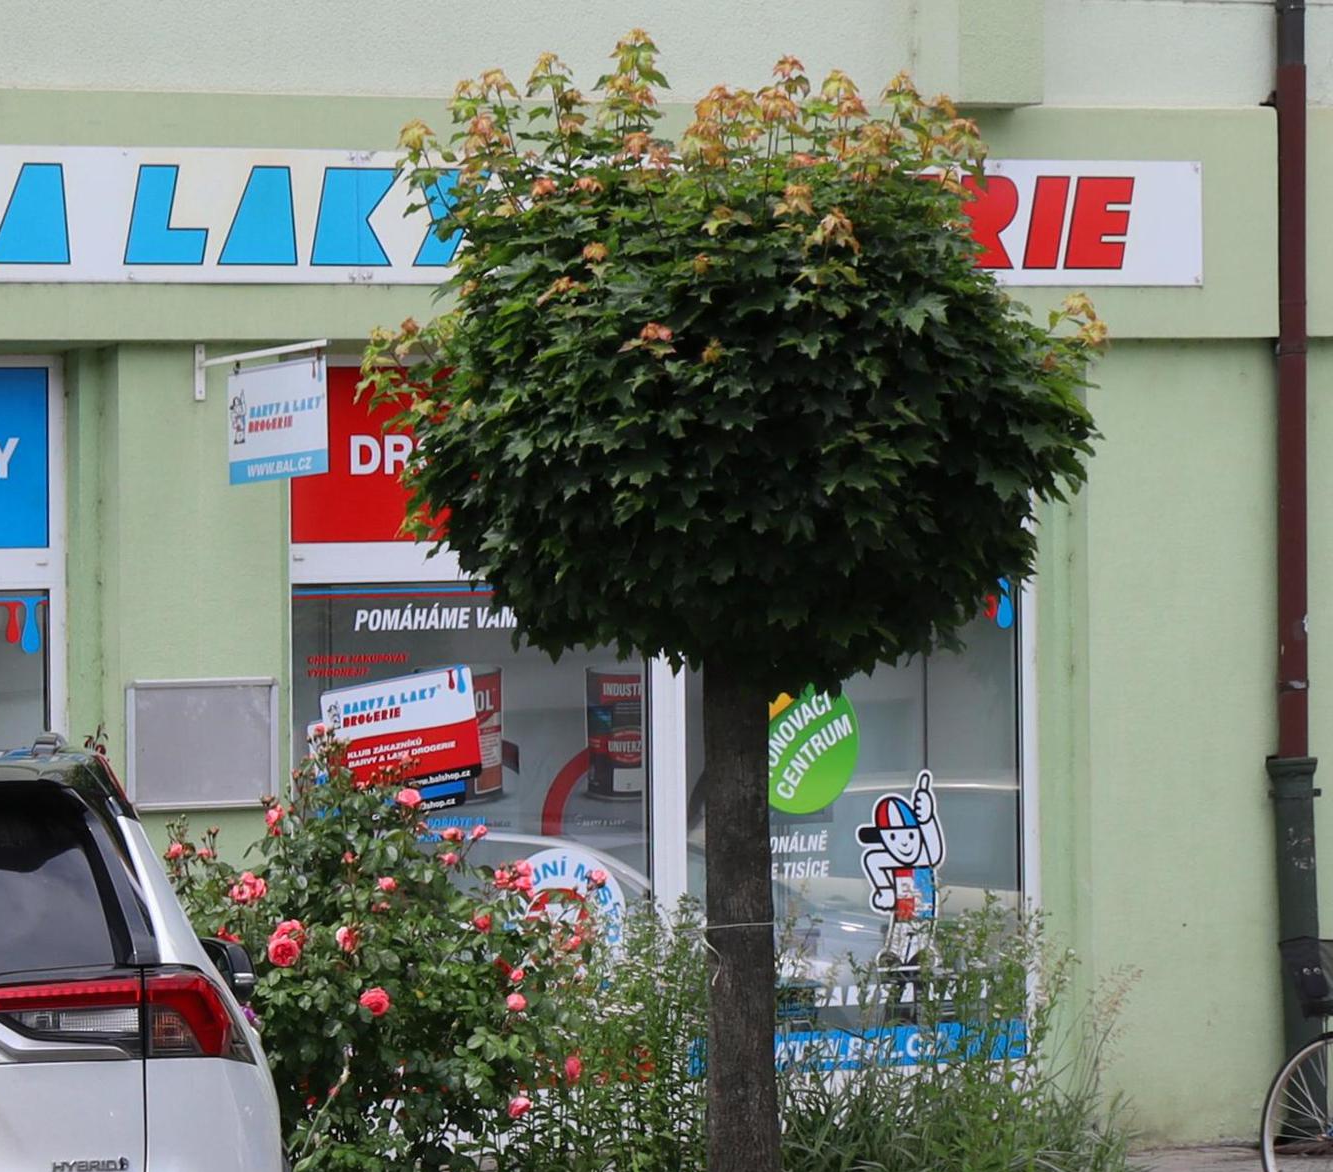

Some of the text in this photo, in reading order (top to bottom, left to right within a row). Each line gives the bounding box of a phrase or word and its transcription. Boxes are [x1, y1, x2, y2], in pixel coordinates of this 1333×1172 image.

[247, 456, 313, 478] WWW.BAL.CZ
[354, 603, 471, 631] POMÁHÁME
[343, 687, 437, 714] BARVY A LAKY
[342, 707, 401, 728] DROGERIE
[347, 737, 423, 760] KLUB ZÁKAZNÍKŮ
[348, 757, 378, 768] BARVY
[411, 740, 456, 756] DROGERIE
[777, 714, 853, 800] CENTRUM
[784, 858, 830, 879] TISÍCE
